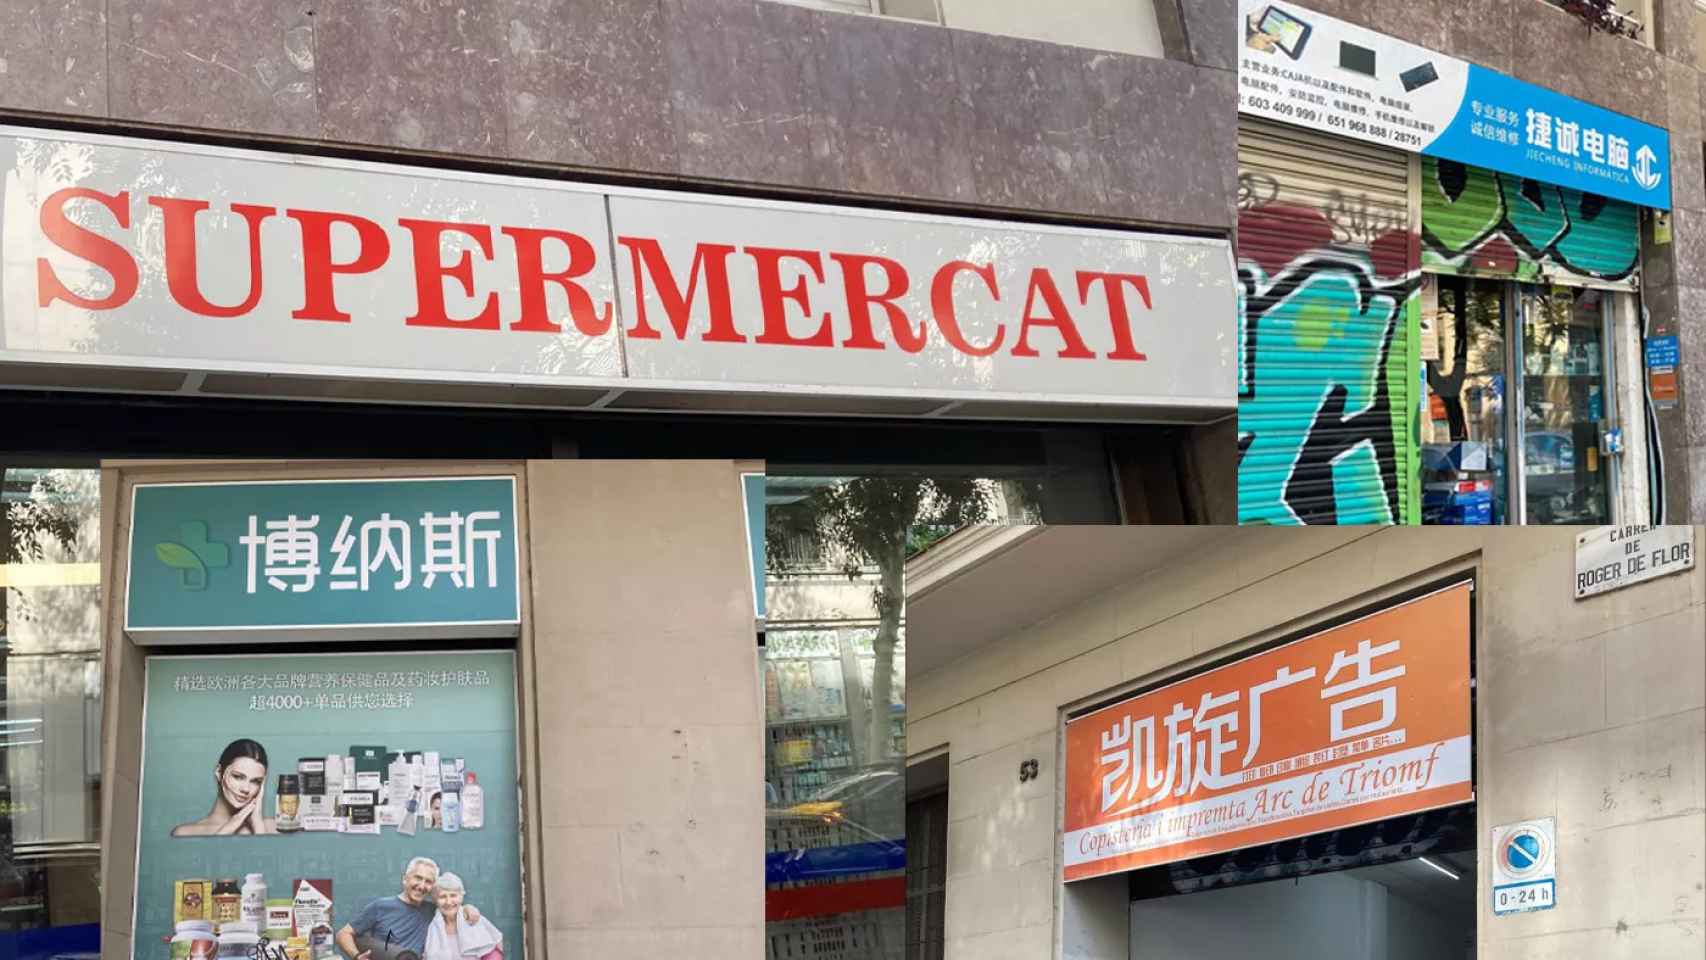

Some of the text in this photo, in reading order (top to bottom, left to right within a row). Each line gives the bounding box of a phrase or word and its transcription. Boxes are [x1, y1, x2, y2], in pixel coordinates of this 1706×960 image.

[1248, 96, 1270, 110] 603
[1272, 102, 1293, 115] 409
[1296, 107, 1316, 121] 999
[1327, 115, 1345, 128] 651
[1348, 120, 1366, 133] 968
[1369, 125, 1387, 138] 888
[1394, 131, 1421, 145] 28751
[1471, 100, 1519, 127] 专业服务
[1525, 107, 1629, 170] 捷诚电脑
[1526, 148, 1571, 169] JIECHENG
[37, 186, 1152, 362] SUPERMERCAT
[239, 511, 502, 594] 博纳斯
[1577, 542, 1690, 589] ROGER DE FLOR
[1625, 539, 1641, 555] DE
[249, 691, 414, 712] 超4000+单品供您选择
[1101, 639, 1407, 817] 凯旋广告
[1019, 758, 1039, 784] 53
[1079, 817, 1152, 856] Copisteria
[1167, 799, 1246, 837] impremta
[1247, 788, 1294, 822] Arc
[1301, 772, 1331, 807] de
[1340, 742, 1446, 796] Triomf
